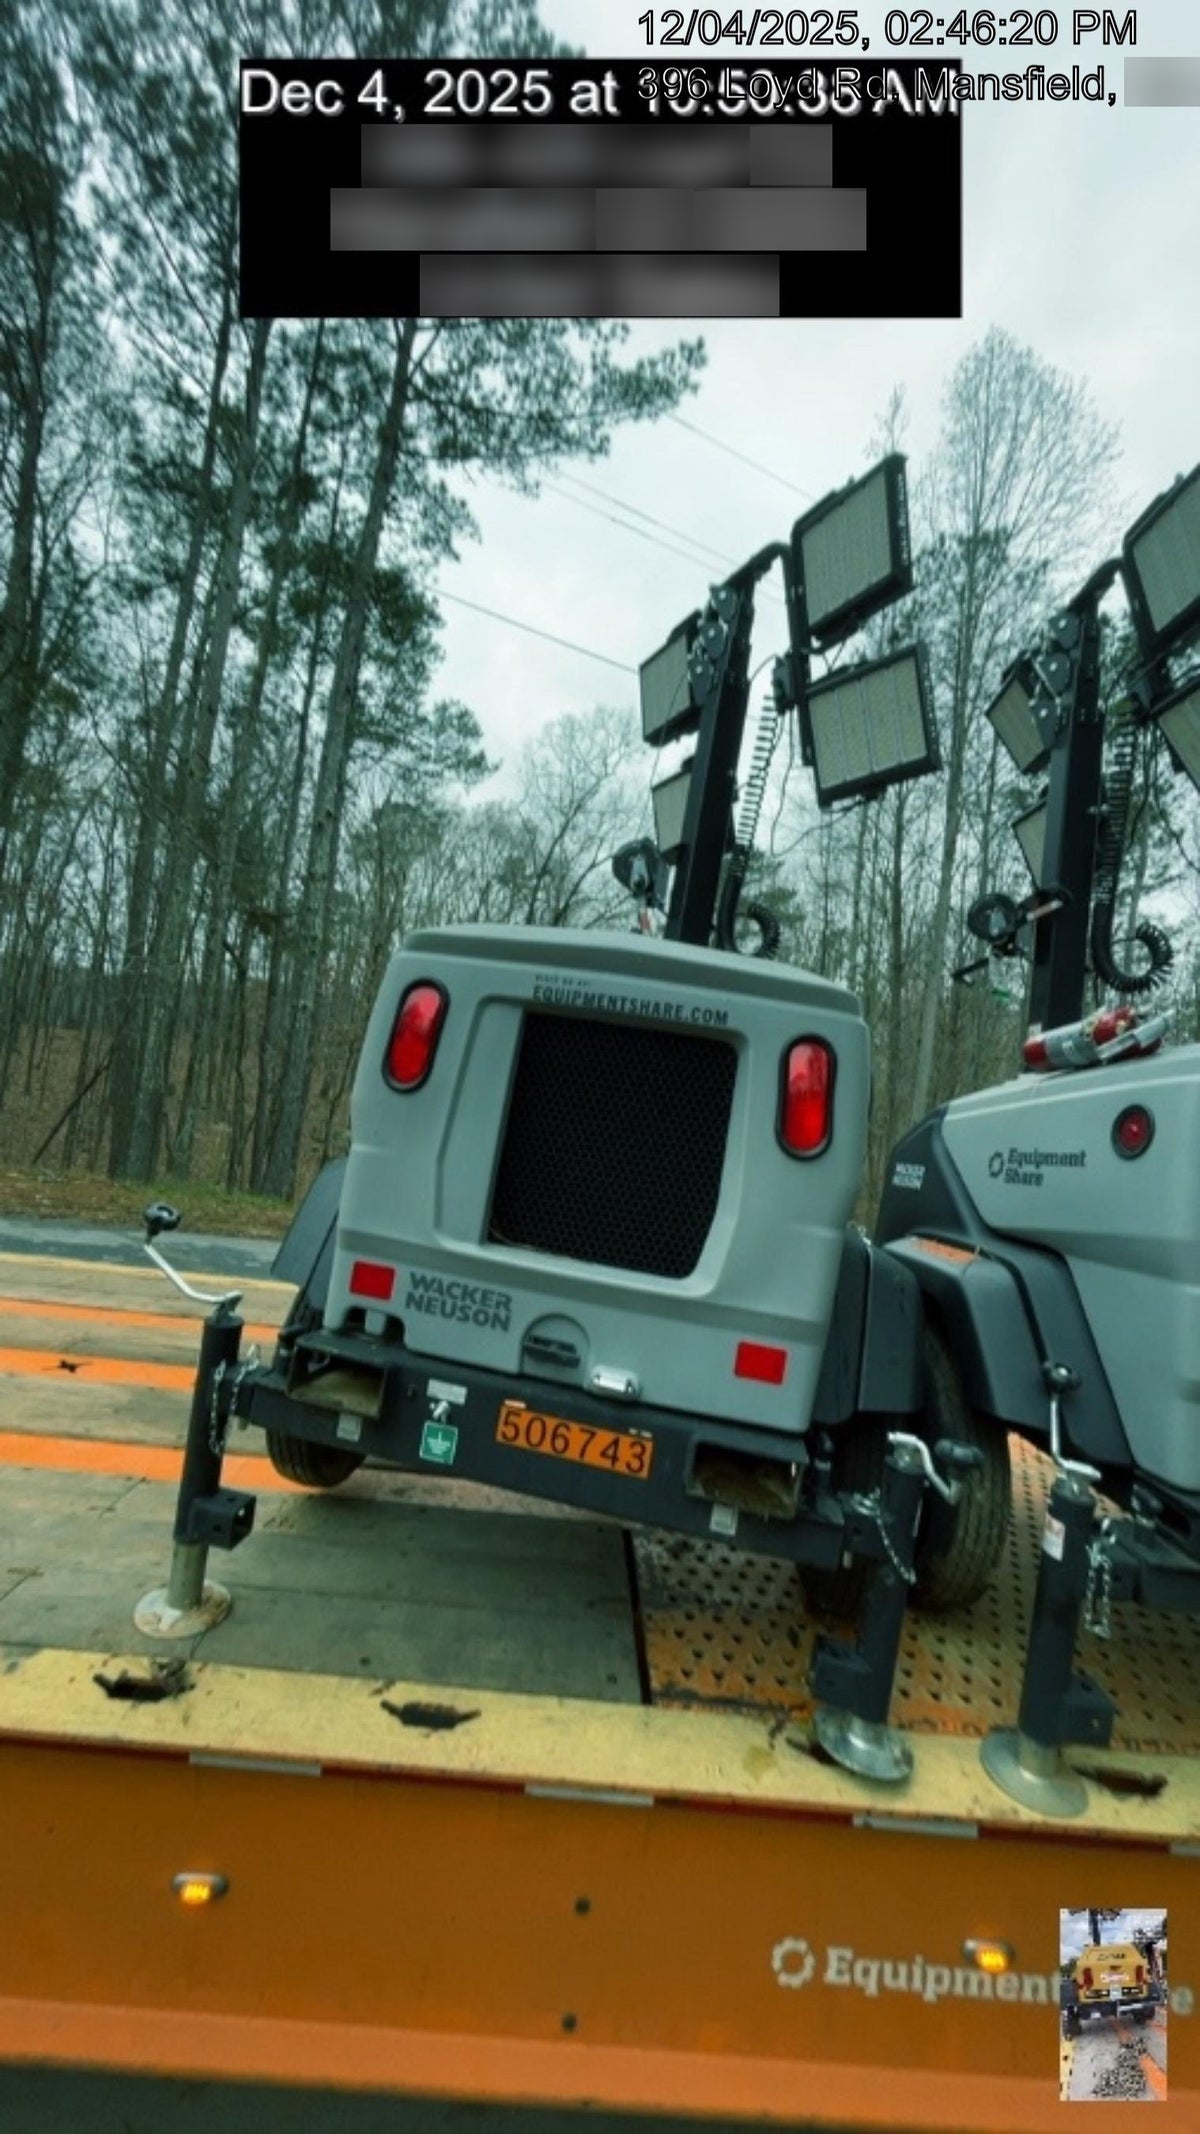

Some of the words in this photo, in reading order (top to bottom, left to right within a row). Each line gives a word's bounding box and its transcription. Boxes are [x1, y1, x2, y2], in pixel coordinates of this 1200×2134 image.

[533, 984, 729, 1026] EQUIPMENTSHARE.COM
[1003, 1168, 1044, 1187] Share
[1007, 1148, 1087, 1169] Equipment
[405, 1291, 511, 1333] NEUSON
[410, 1271, 512, 1312] WACKER
[501, 1409, 647, 1474] 506743
